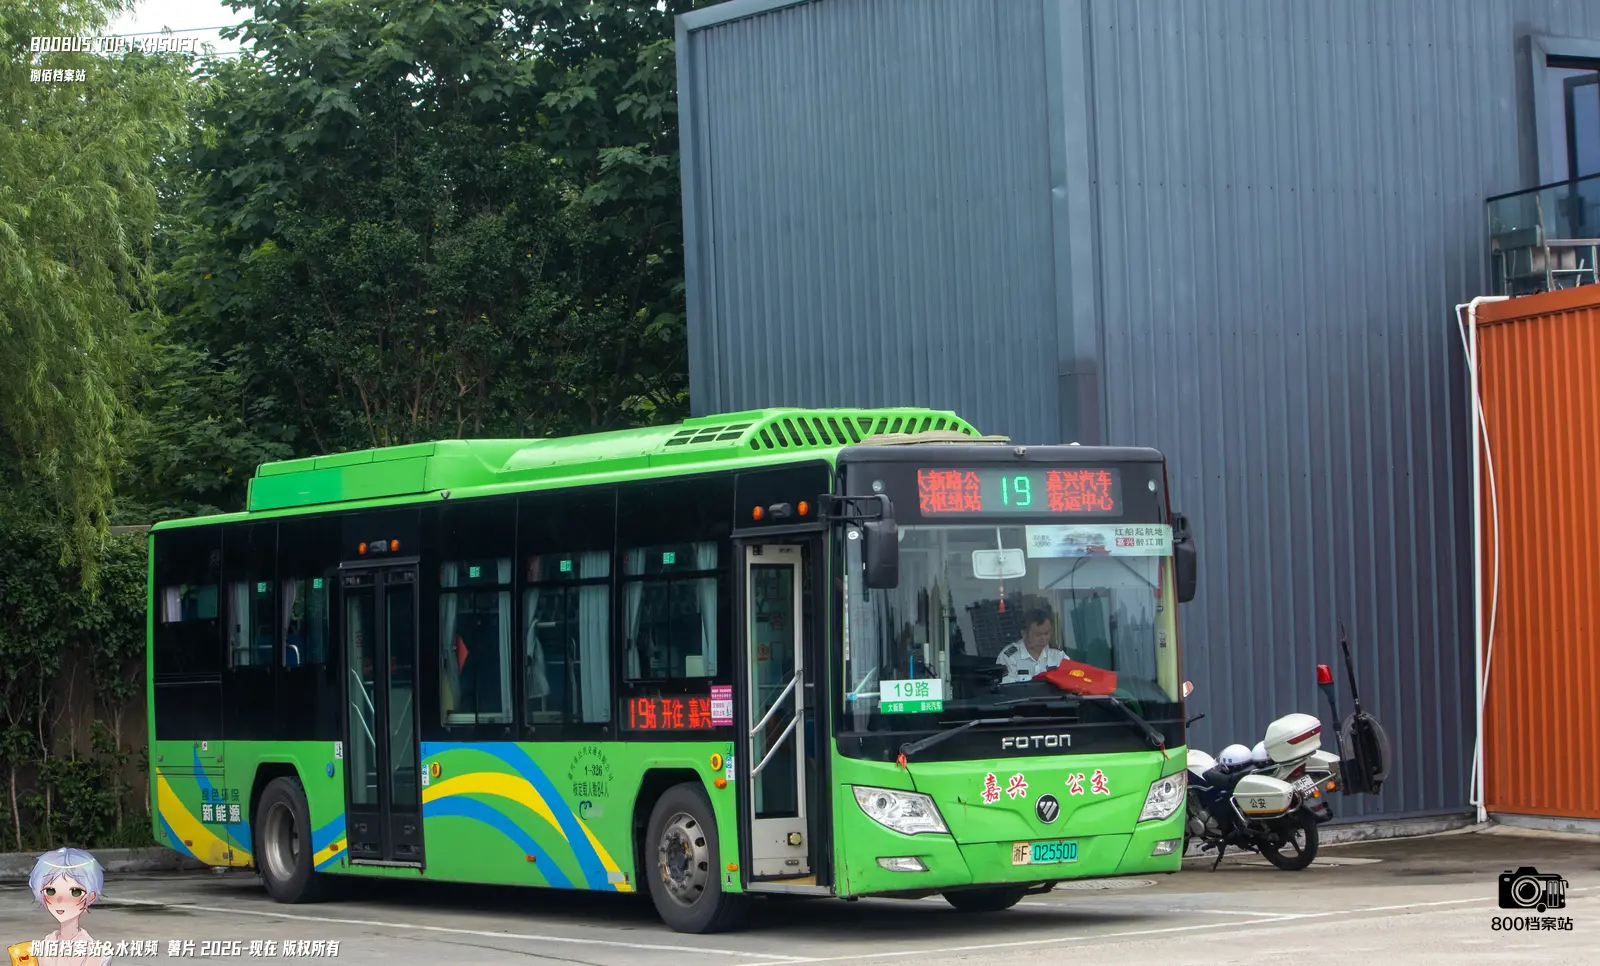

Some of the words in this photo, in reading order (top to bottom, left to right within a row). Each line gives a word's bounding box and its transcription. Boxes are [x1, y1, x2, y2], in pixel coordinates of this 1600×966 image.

[1046, 470, 1113, 491] 嘉兴汽车
[1002, 476, 1031, 505] 19
[1048, 491, 1114, 512] 客运中心
[894, 681, 929, 697] 19路
[888, 703, 903, 712] 大新路
[1002, 734, 1071, 750] FOTON
[584, 764, 603, 776] 1-326
[981, 772, 1028, 804] 嘉兴
[1065, 769, 1110, 795] 公交
[1250, 798, 1266, 808] 公安
[202, 804, 240, 822] 新能源
